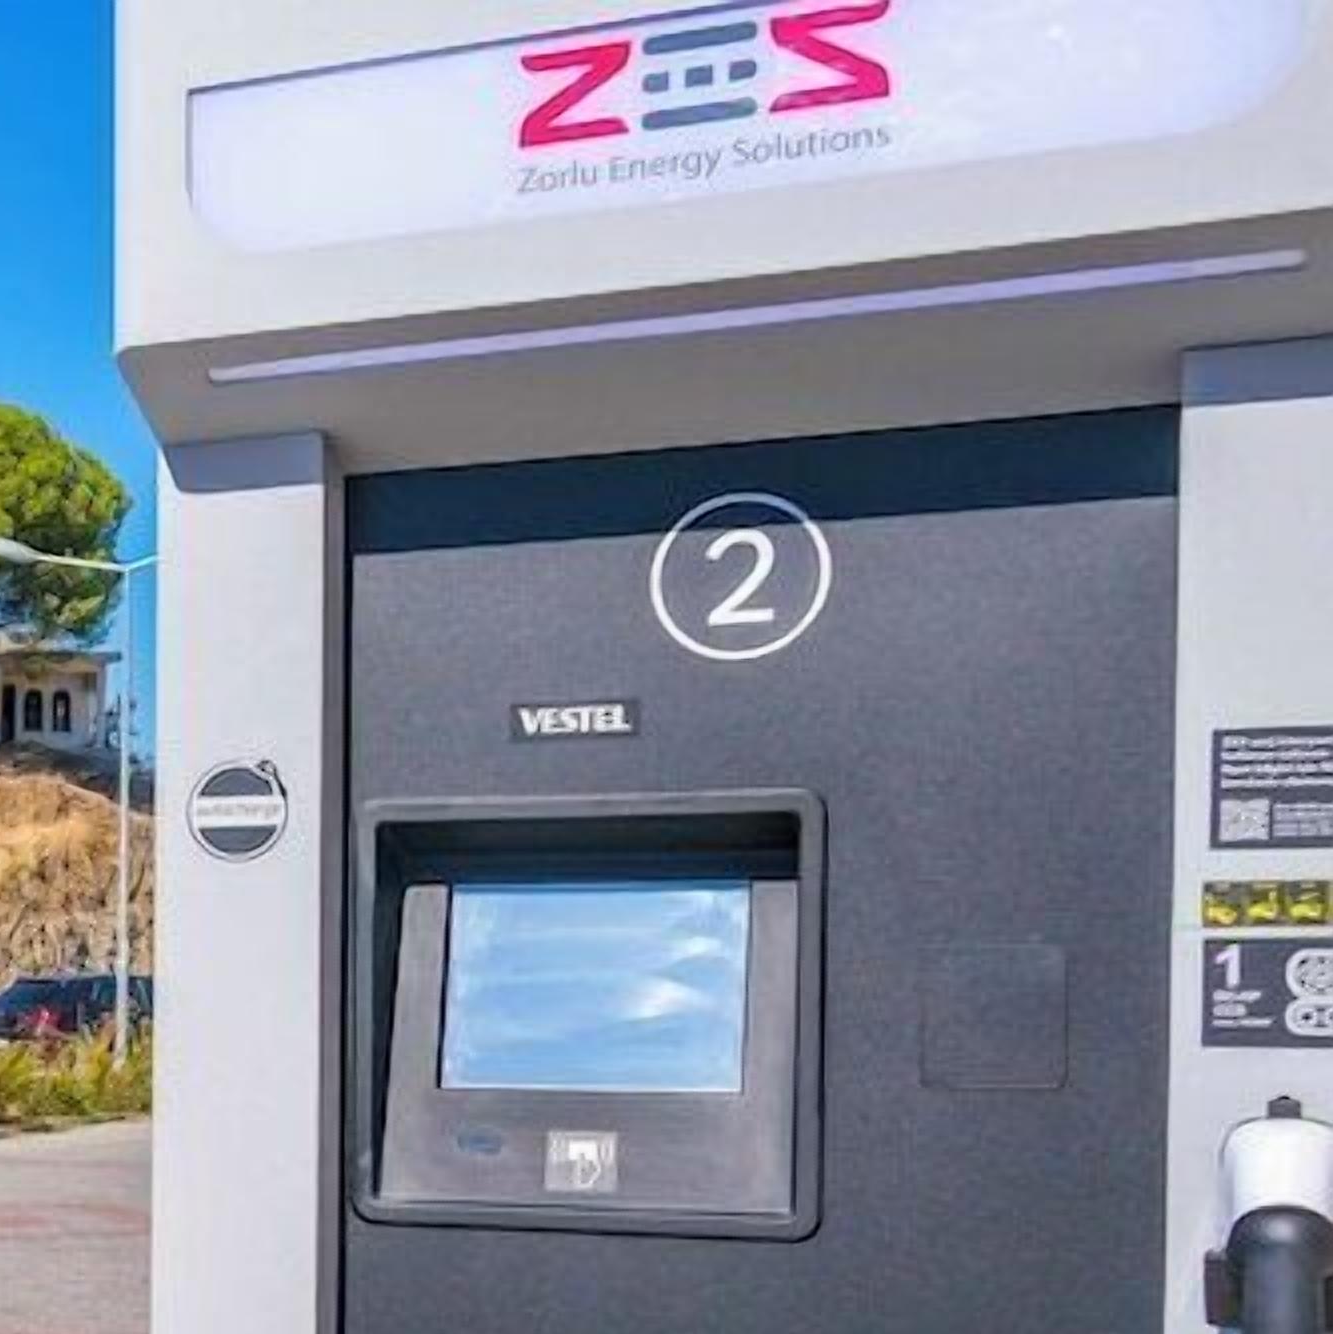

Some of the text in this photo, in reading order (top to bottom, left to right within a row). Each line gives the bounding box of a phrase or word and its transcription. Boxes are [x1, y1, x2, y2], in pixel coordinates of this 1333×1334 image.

[519, 0, 891, 148] ZES
[517, 124, 891, 195] Zorlu Energy Solutions
[705, 528, 775, 627] 2
[518, 704, 632, 735] VESTEL
[1214, 943, 1241, 988] 1
